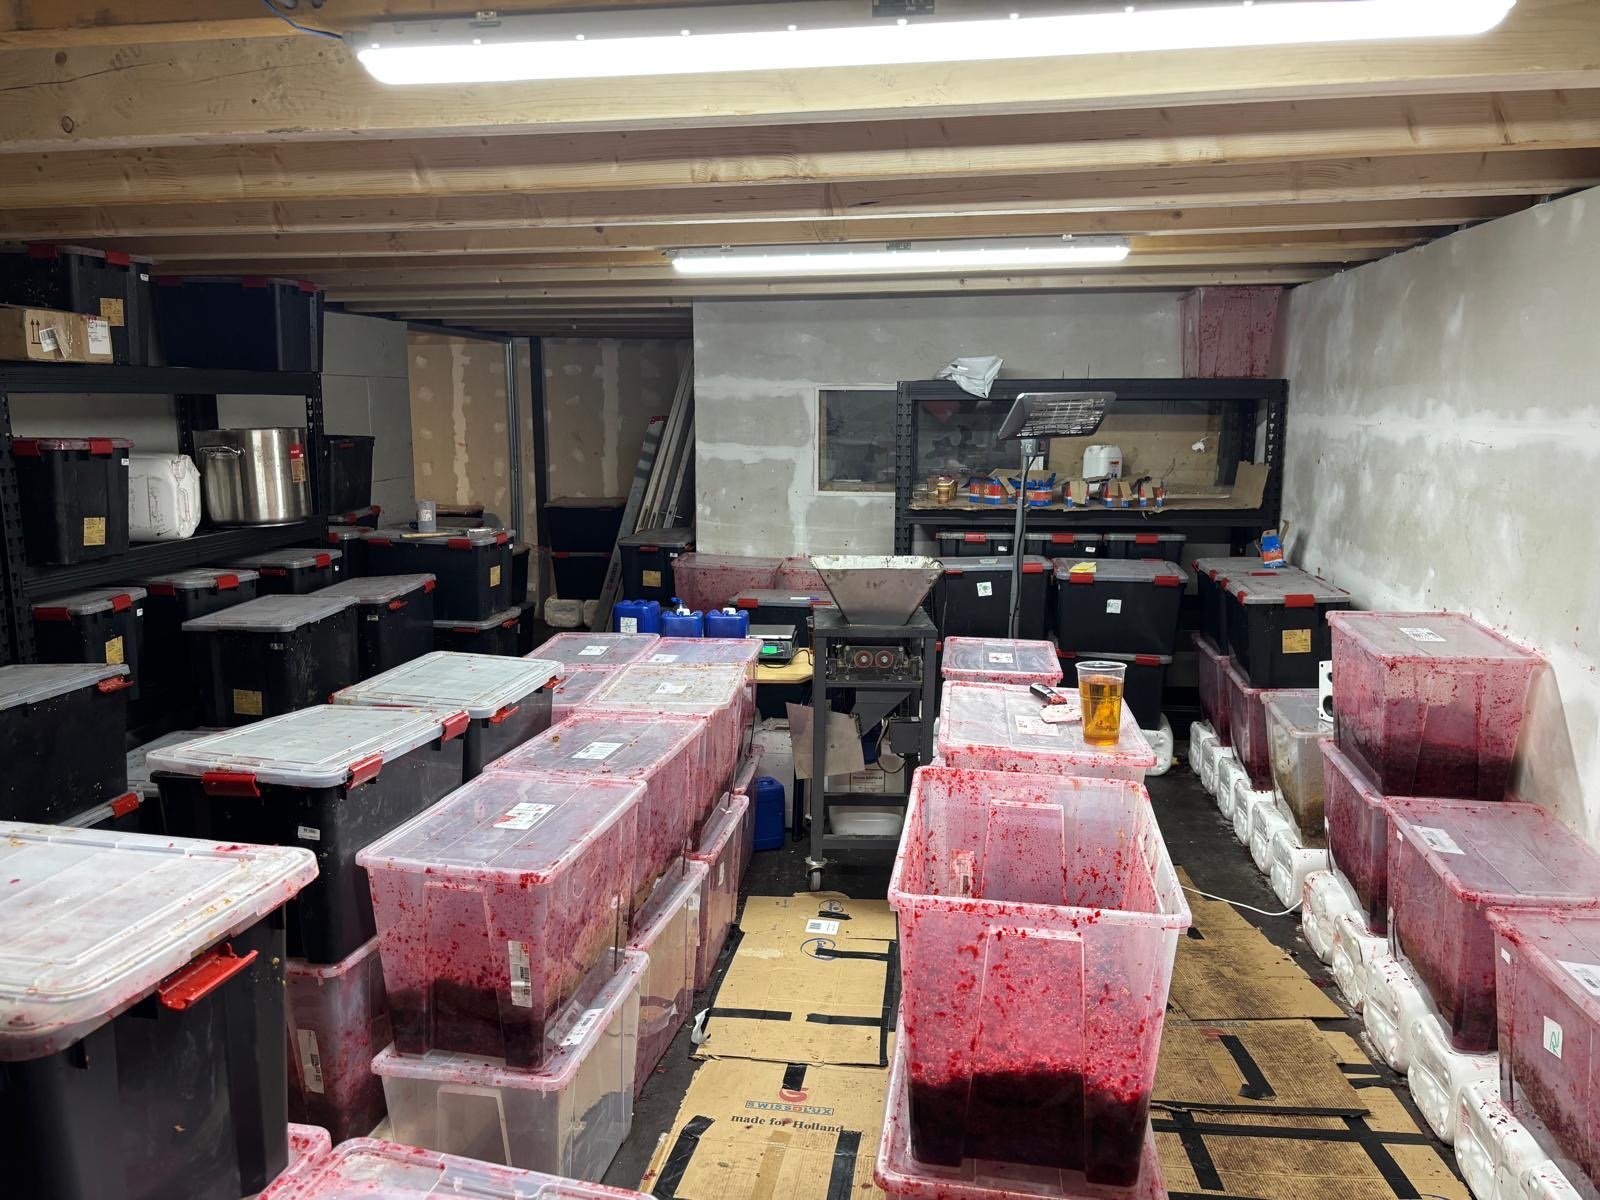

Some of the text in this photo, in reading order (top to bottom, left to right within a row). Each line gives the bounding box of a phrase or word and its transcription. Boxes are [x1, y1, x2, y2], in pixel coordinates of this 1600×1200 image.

[731, 1115, 844, 1133] made for Holland
